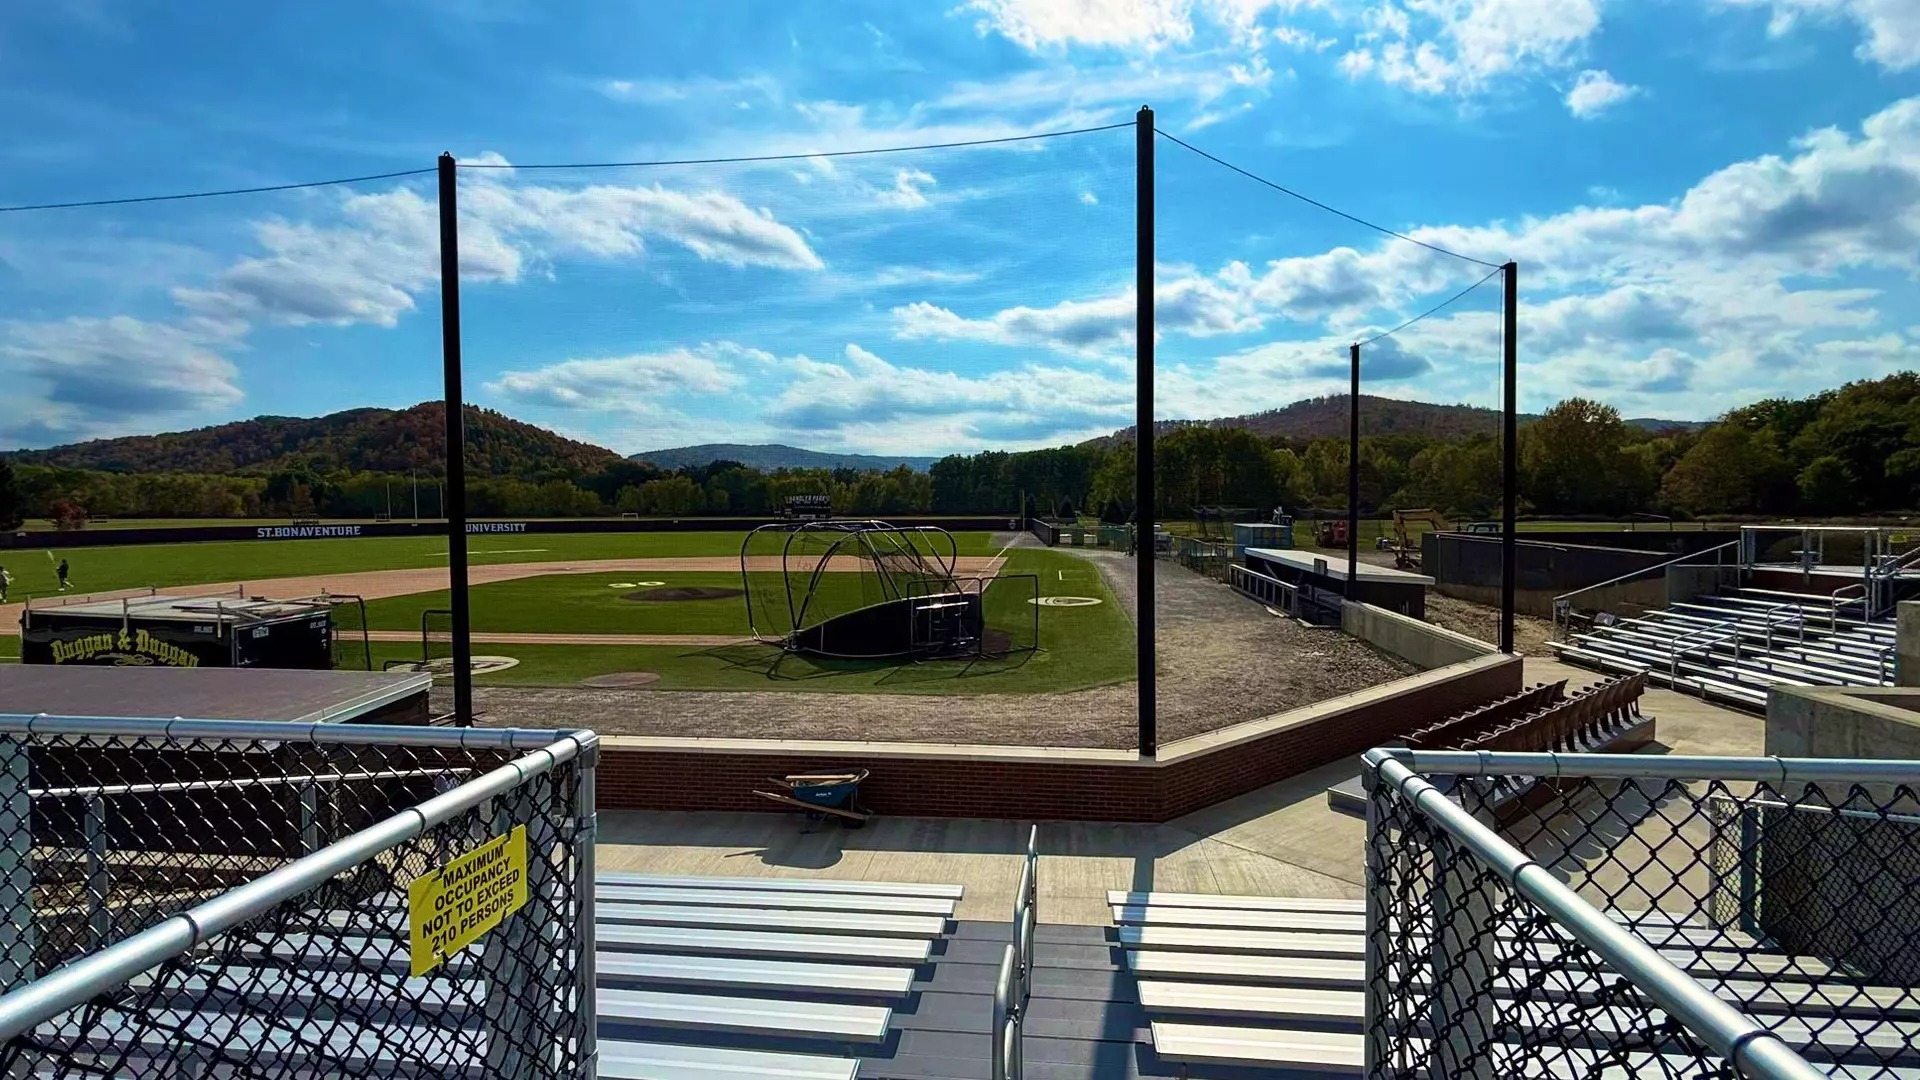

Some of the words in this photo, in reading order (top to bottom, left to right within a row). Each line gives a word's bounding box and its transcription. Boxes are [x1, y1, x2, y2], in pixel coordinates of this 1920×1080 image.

[465, 523, 527, 533] UNIVERSITY
[50, 633, 113, 664] Duggan
[117, 627, 131, 651] &
[136, 628, 200, 667] Duggan
[435, 857, 511, 911] OCCUPANCY
[443, 843, 504, 888] MAXIMUM
[422, 907, 453, 938] NOT
[456, 899, 473, 918] TO
[477, 868, 519, 904] EXCEED
[431, 926, 457, 953] 210
[460, 888, 514, 935] PERSONS
